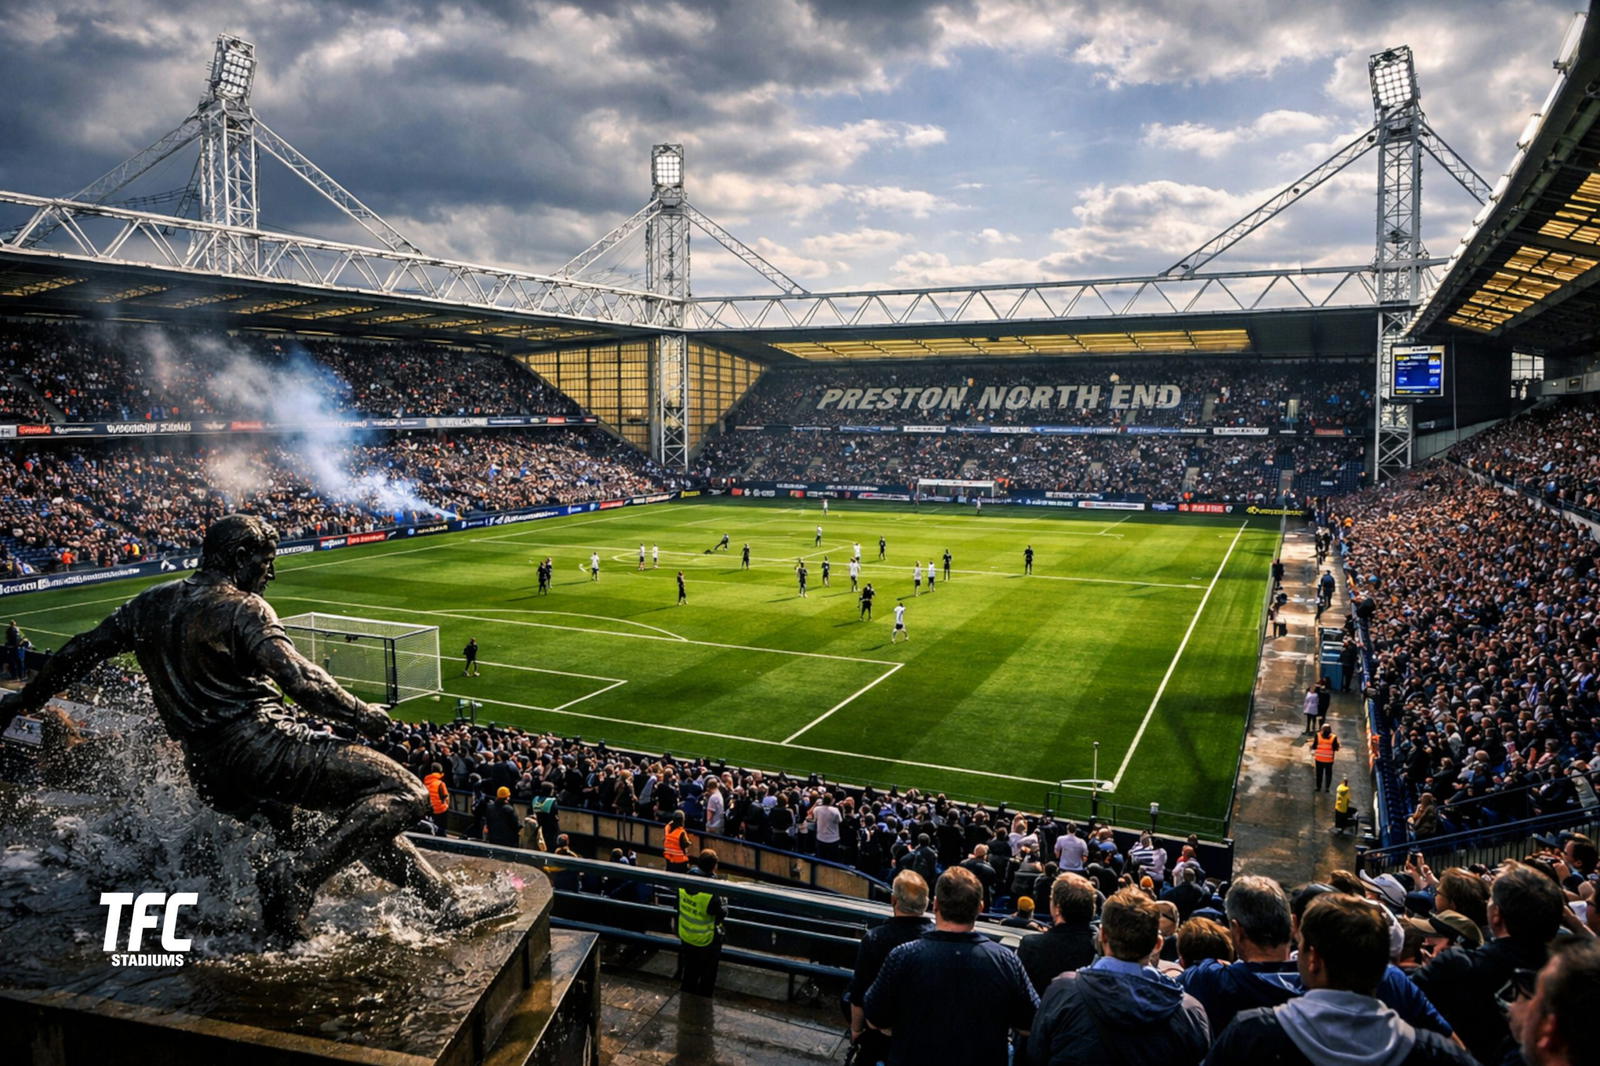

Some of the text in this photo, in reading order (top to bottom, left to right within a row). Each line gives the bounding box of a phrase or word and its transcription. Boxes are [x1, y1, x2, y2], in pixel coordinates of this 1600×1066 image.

[816, 384, 1182, 410] PRESTON NORTH END
